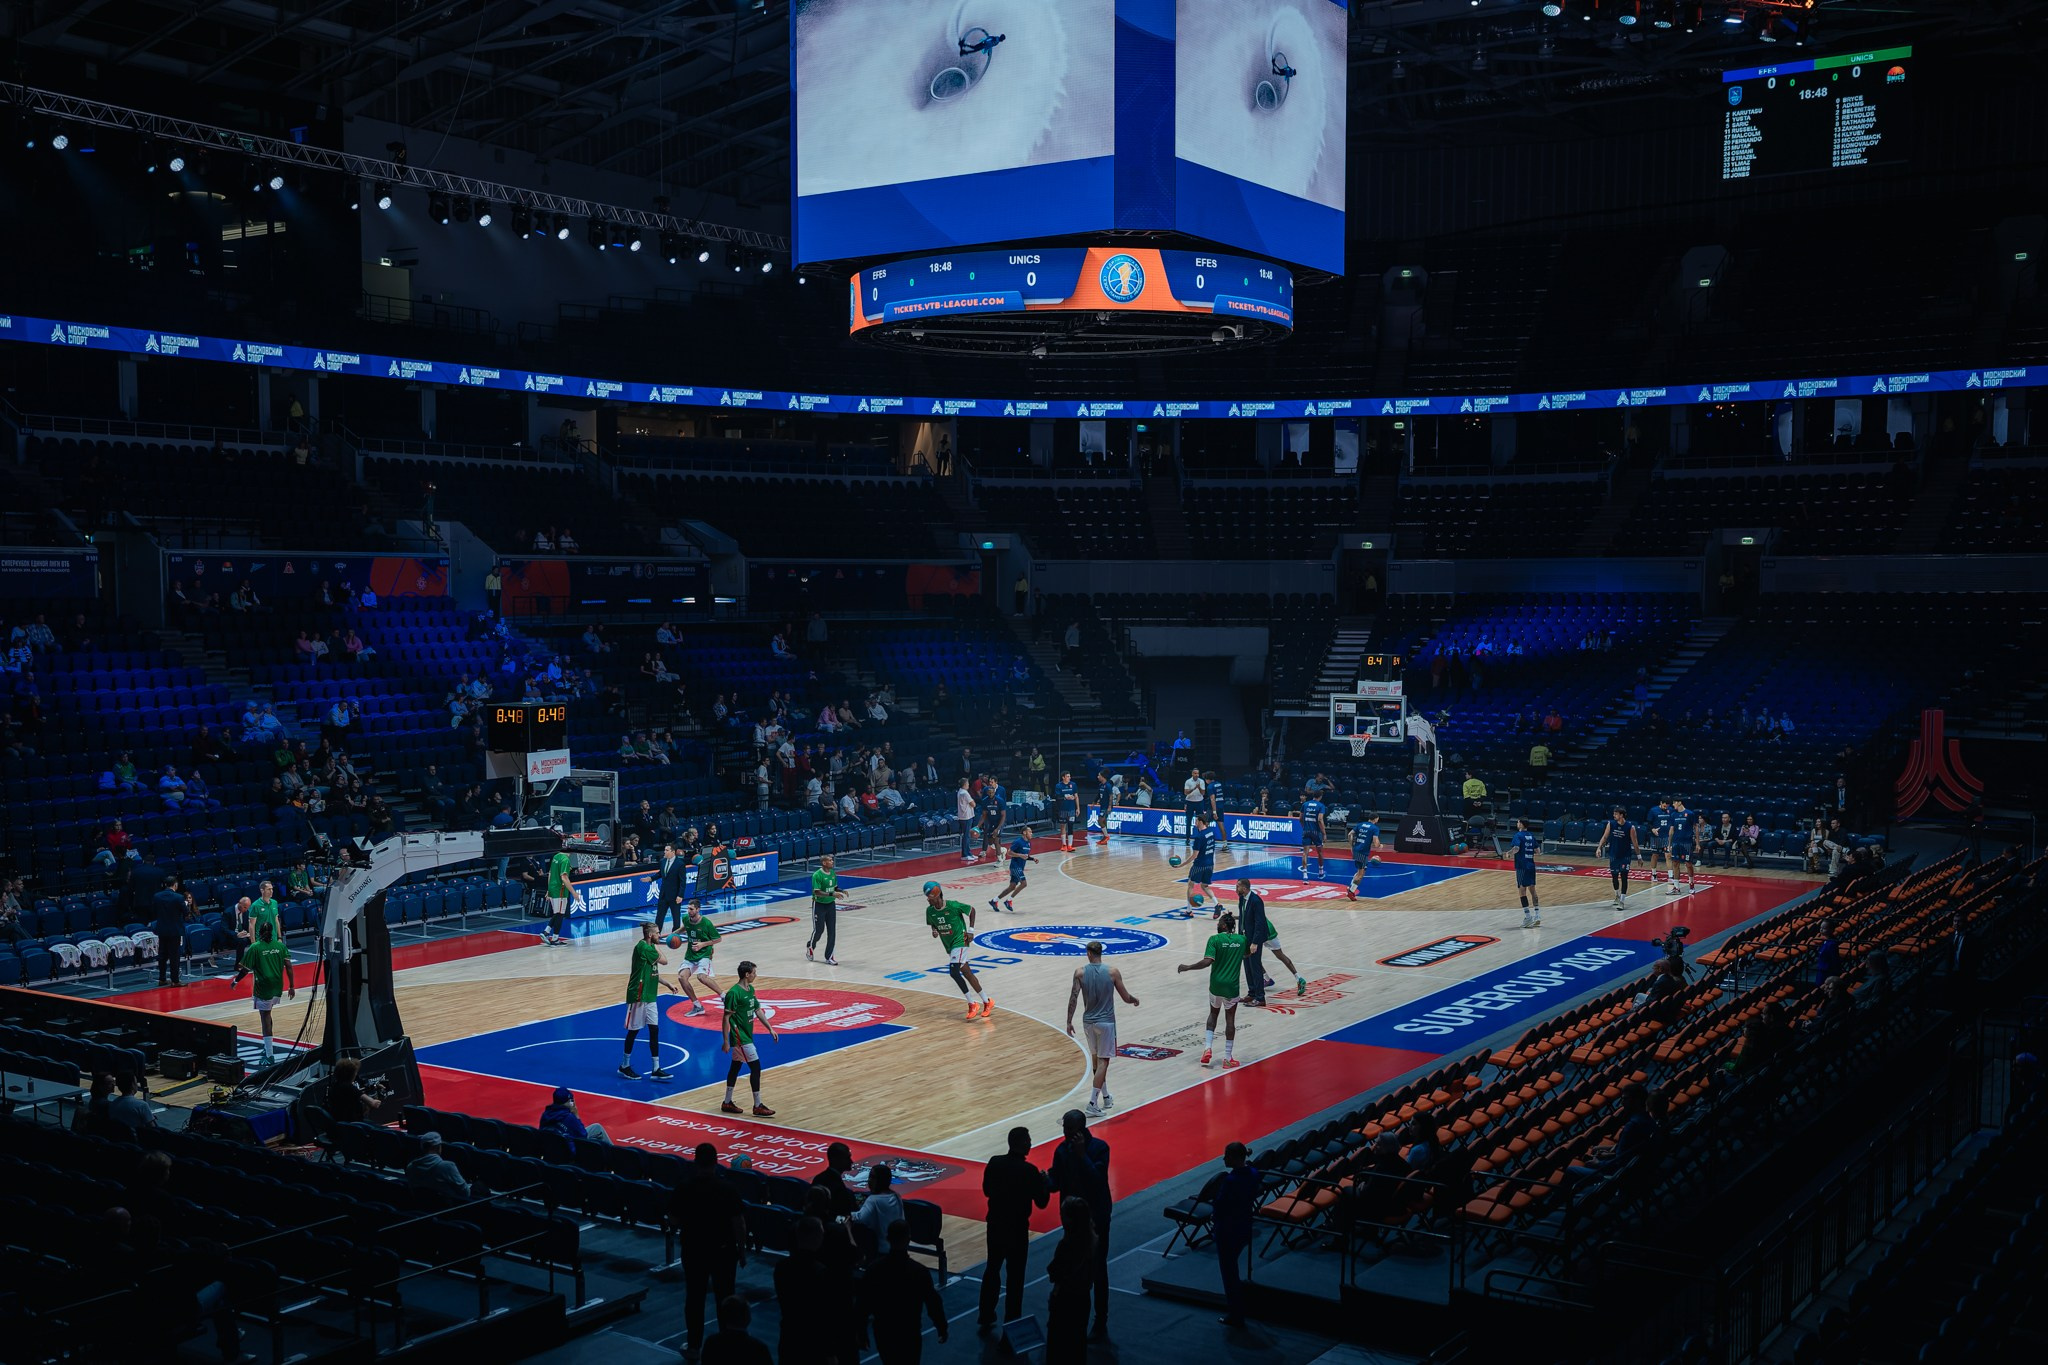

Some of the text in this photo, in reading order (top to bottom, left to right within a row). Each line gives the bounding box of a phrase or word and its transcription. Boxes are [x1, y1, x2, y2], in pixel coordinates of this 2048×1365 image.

[1850, 54, 1874, 62] UNICS
[1758, 68, 1777, 76] EFES
[1832, 73, 1838, 81] 0
[1852, 66, 1860, 78] 0
[1768, 77, 1776, 90] 0
[1790, 79, 1796, 87] 0
[1799, 87, 1828, 100] 18:48
[1732, 131, 1760, 139] MALCOLM
[1842, 134, 1882, 143] MCCORMACK
[1010, 254, 1040, 265] UNICS
[1196, 258, 1218, 268] EFES
[930, 262, 952, 273] 18:48
[872, 269, 887, 280] EFES
[970, 272, 975, 280] 0
[1026, 272, 1036, 286] 0
[1260, 268, 1273, 280] 18:48
[910, 278, 914, 287] 0
[1196, 274, 1204, 289] 0
[1244, 278, 1248, 286] 0
[872, 287, 878, 302] 0
[894, 298, 1004, 314] TICKETS.VTB-LEAGUE.COM
[68, 326, 109, 337] МОСКОВСКИЙ
[69, 335, 87, 345] СПОРТ
[161, 336, 199, 347] МОСКОВСКИЙ
[162, 345, 179, 354] СПОРТ
[248, 345, 282, 356] МОСКОВСКИЙ
[248, 354, 263, 363] СПОРТ
[1984, 369, 2025, 378] МОСКОВСКИЙ
[1799, 380, 1837, 388] МОСКОВСКИЙ
[1889, 375, 1928, 384] МОСКОВСКИЙ
[1632, 388, 1666, 397] МОСКОВСКИЙ
[1714, 385, 1749, 393] МОСКОВСКИЙ
[1714, 393, 1731, 401] СПОРТ
[1090, 402, 1124, 410] МОСКОВСКИЙ
[1165, 402, 1199, 410] МОСКОВСКИЙ
[1241, 402, 1275, 410] МОСКОВСКИЙ
[1249, 820, 1292, 832] МОСКОВСКИЙ
[1248, 830, 1270, 840] СПОРТ
[348, 876, 372, 904] SPALDING
[588, 880, 632, 898] МОСКОВСКИЙ
[588, 896, 610, 910] СПОРТ
[1388, 940, 1476, 966] WINLINE
[1394, 969, 1576, 1035] SUPERCUP
[1550, 948, 1636, 972] 2026
[646, 1114, 752, 1140] Москвы
[728, 1142, 824, 1164] спорта
